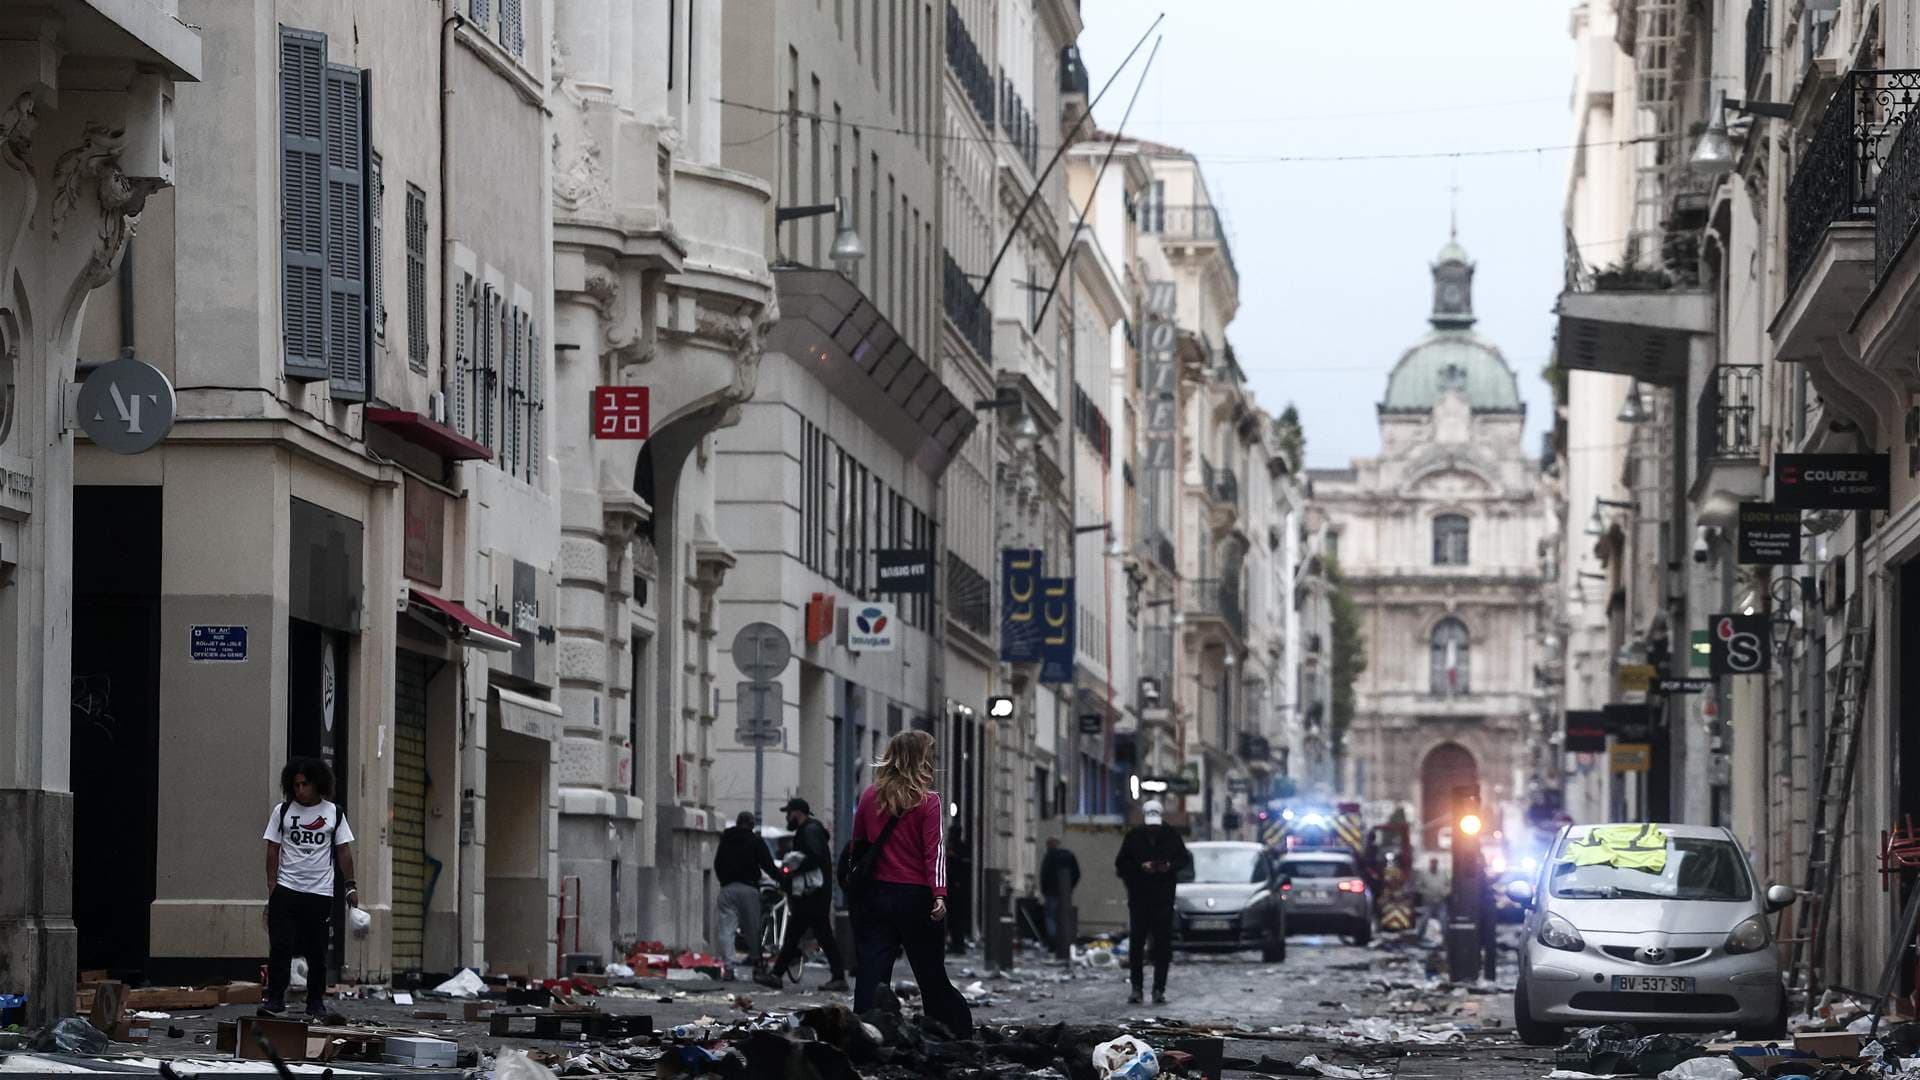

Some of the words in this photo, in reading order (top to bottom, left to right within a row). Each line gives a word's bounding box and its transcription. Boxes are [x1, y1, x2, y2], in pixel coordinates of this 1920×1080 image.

[1803, 470, 1869, 481] COURIR
[290, 816, 300, 829] I
[290, 830, 325, 846] QRO
